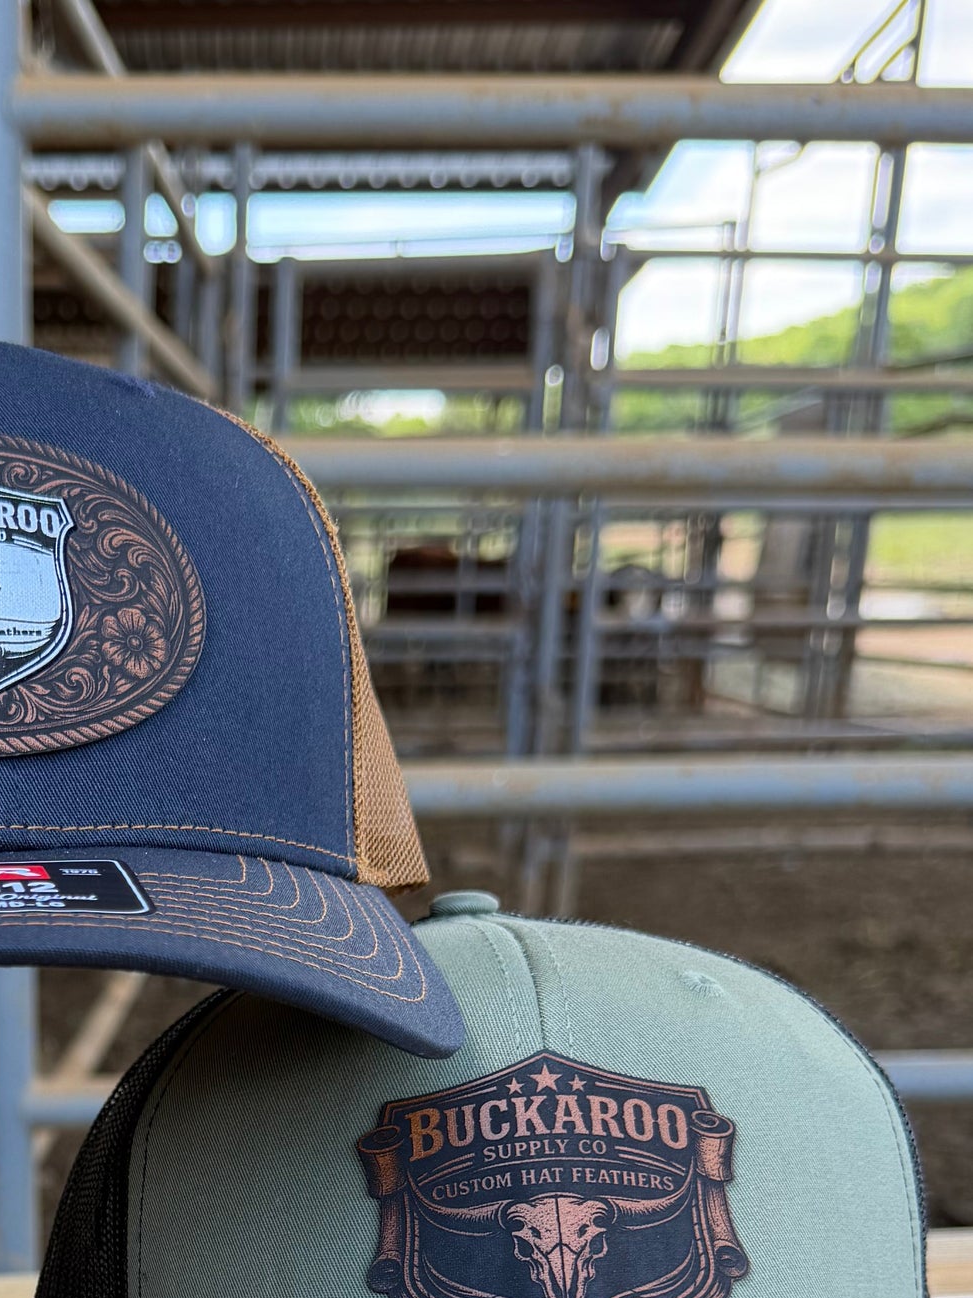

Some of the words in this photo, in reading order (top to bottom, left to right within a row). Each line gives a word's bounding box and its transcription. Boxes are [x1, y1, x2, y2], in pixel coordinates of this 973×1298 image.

[404, 1093, 689, 1163] BUCKAROO
[482, 1138, 570, 1163] SUPPLY
[578, 1138, 607, 1156] CO
[432, 1171, 513, 1201] CUSTOM
[521, 1167, 565, 1186] HAT
[572, 1167, 675, 1192] FEATHERS
